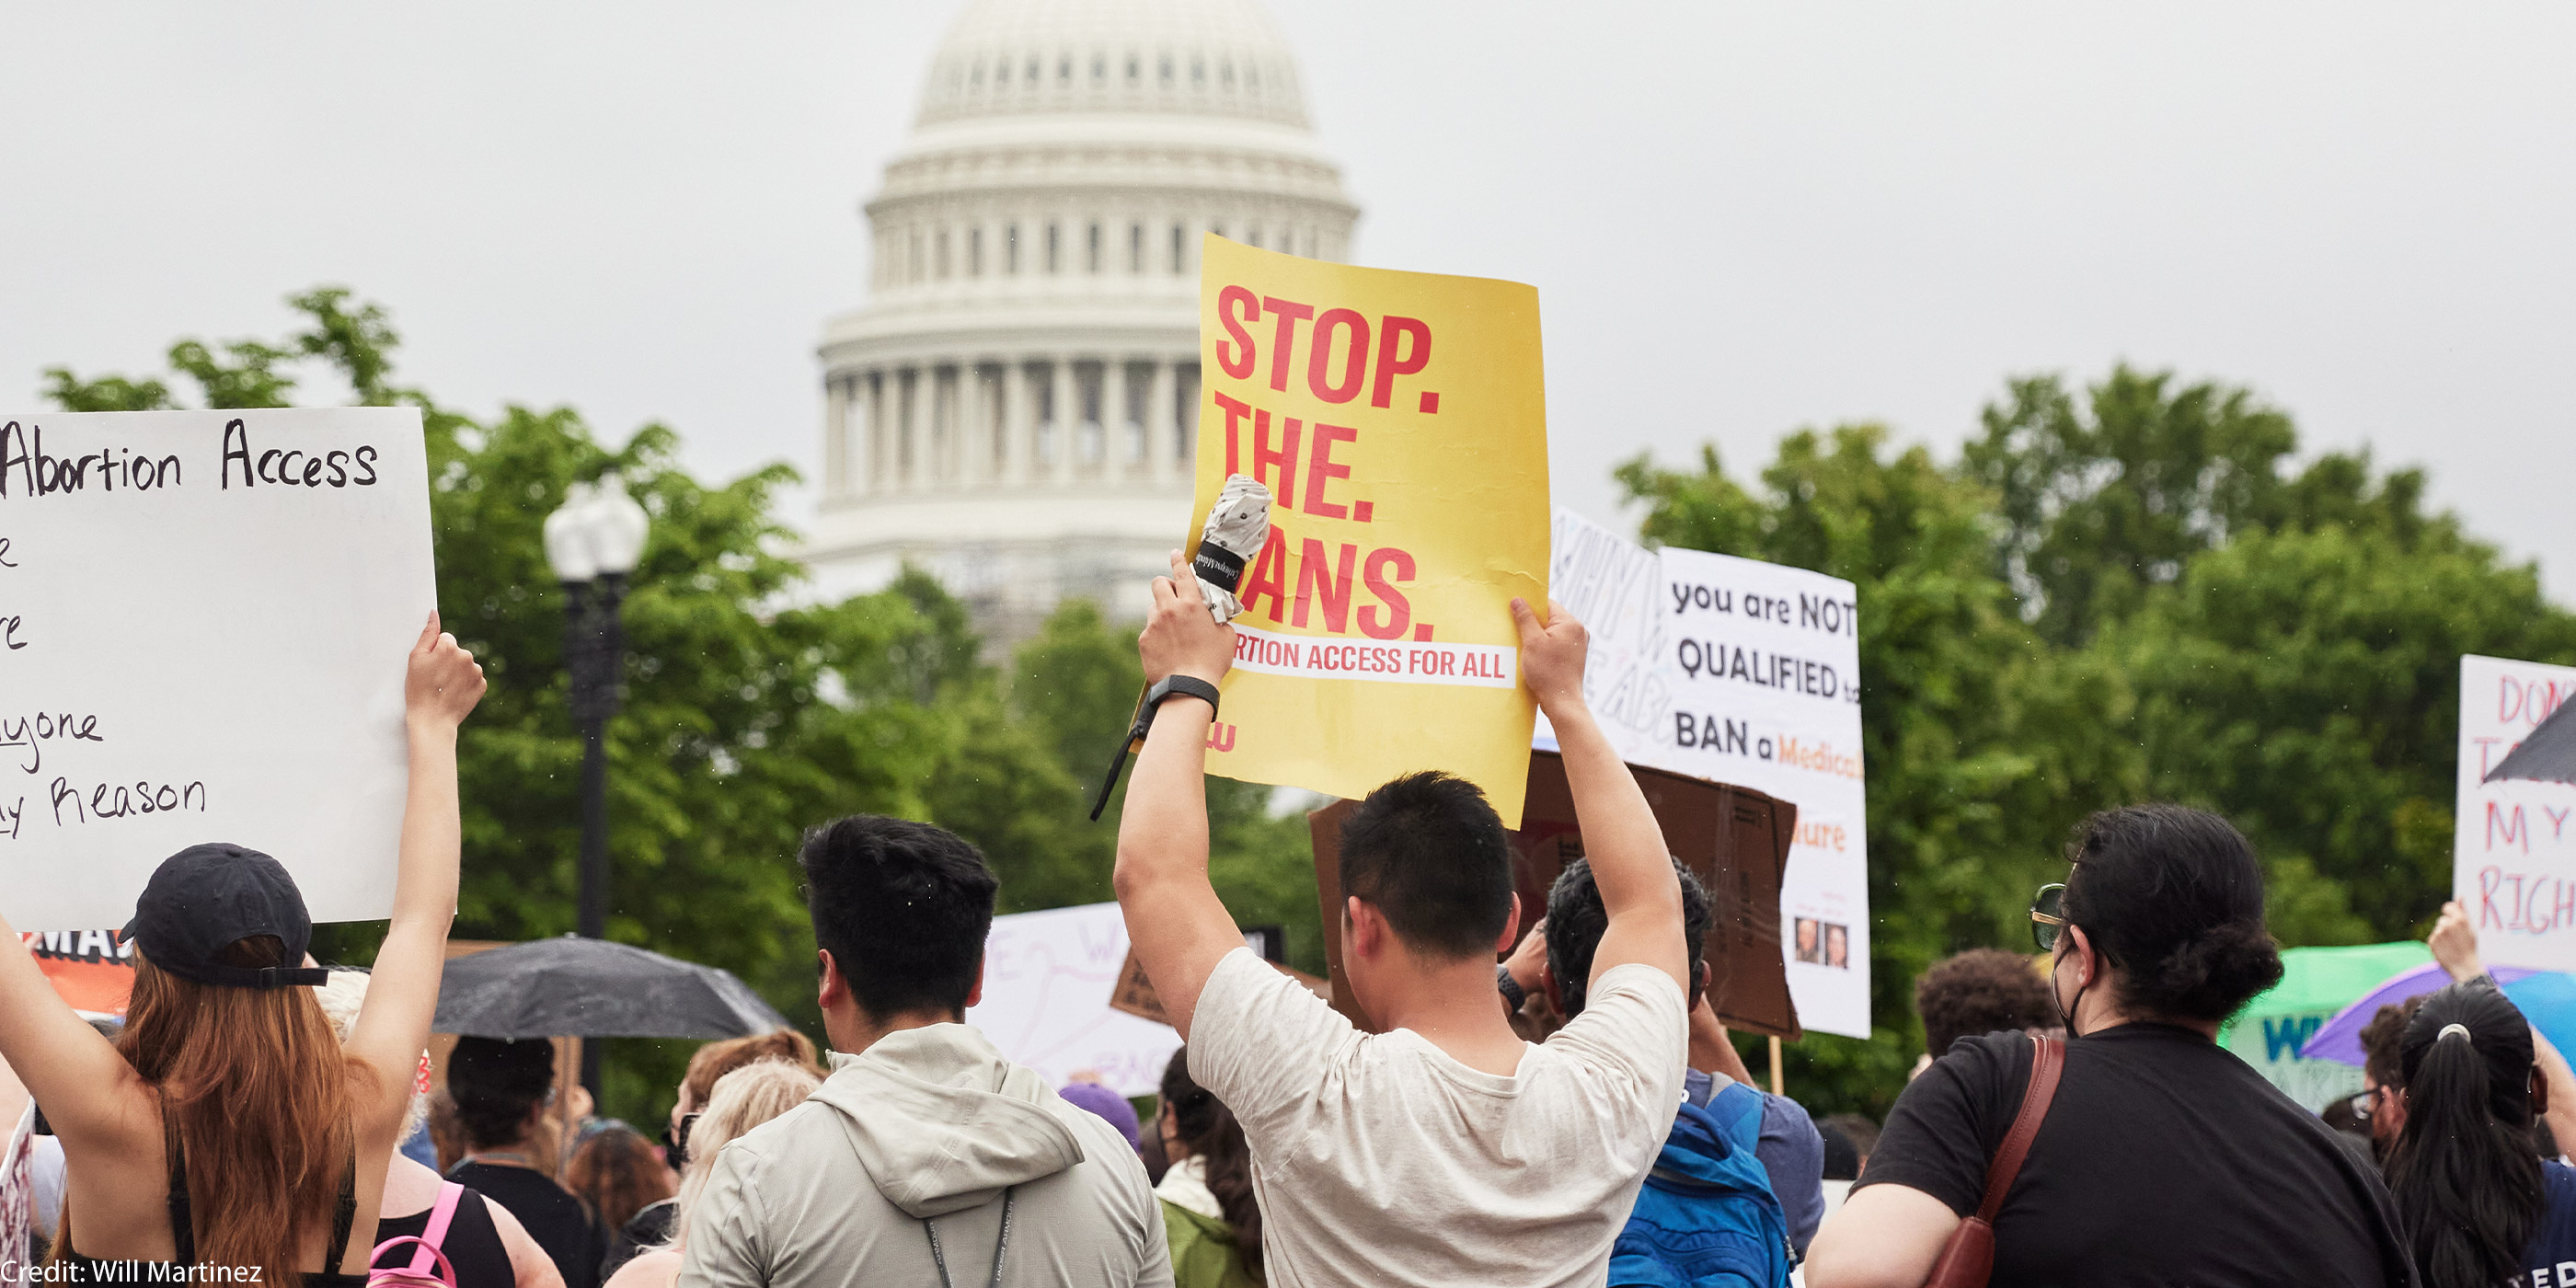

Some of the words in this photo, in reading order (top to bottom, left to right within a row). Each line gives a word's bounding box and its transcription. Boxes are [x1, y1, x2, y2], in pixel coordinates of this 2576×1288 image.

[1215, 285, 1440, 415] STOP.
[0, 420, 181, 498] Abortion
[222, 419, 377, 490] Access
[1214, 390, 1374, 523] THE.
[1234, 523, 1434, 642] ANS.
[1673, 583, 1732, 614] you
[1744, 594, 1790, 625] are
[1800, 593, 1857, 637] NOT
[1307, 646, 1401, 673] ACCESS
[1409, 650, 1455, 675] FOR
[1462, 652, 1505, 678] ALL
[1678, 638, 1838, 699] QUALIFIED
[1675, 712, 1748, 755] BAN
[1758, 739, 1773, 760] a
[1778, 733, 1865, 780] Medical
[52, 776, 205, 826] Reason
[2486, 799, 2570, 857] MY
